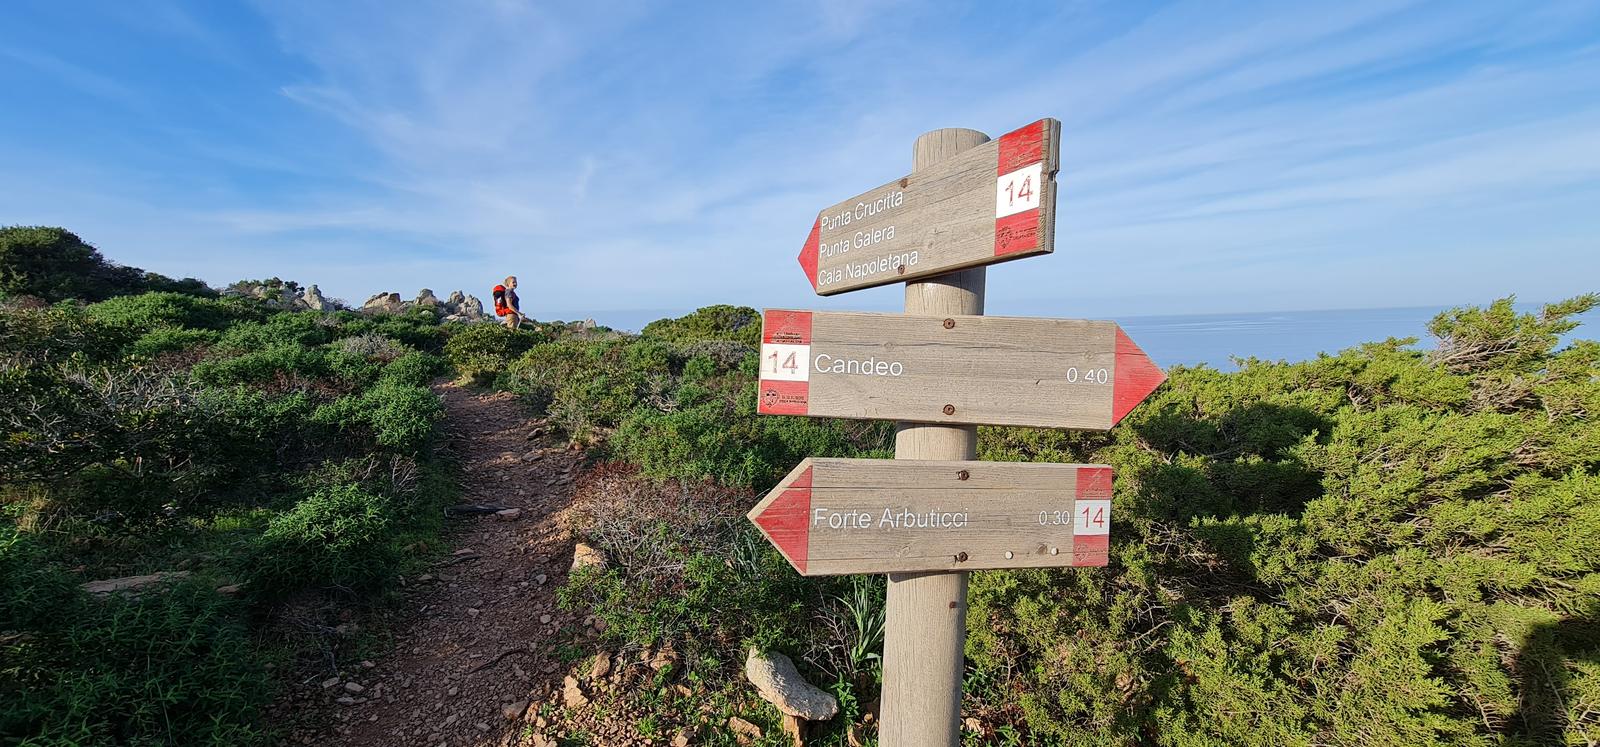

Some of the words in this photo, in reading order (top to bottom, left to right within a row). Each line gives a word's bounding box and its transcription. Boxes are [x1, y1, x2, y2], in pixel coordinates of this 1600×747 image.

[1005, 175, 1034, 207] 14
[821, 211, 851, 232] Punta
[855, 191, 903, 220] Crucitta
[820, 239, 850, 258] Punta
[854, 225, 895, 249] Galera
[818, 268, 842, 286] Cala
[845, 250, 918, 280] Napoletana
[768, 350, 798, 374] 14
[814, 353, 903, 376] Candeo
[1066, 367, 1108, 384] 0.40
[814, 507, 872, 529] Forte
[879, 507, 969, 529] Arbuticci
[1038, 510, 1070, 525] 0.30
[1082, 506, 1105, 529] 14
